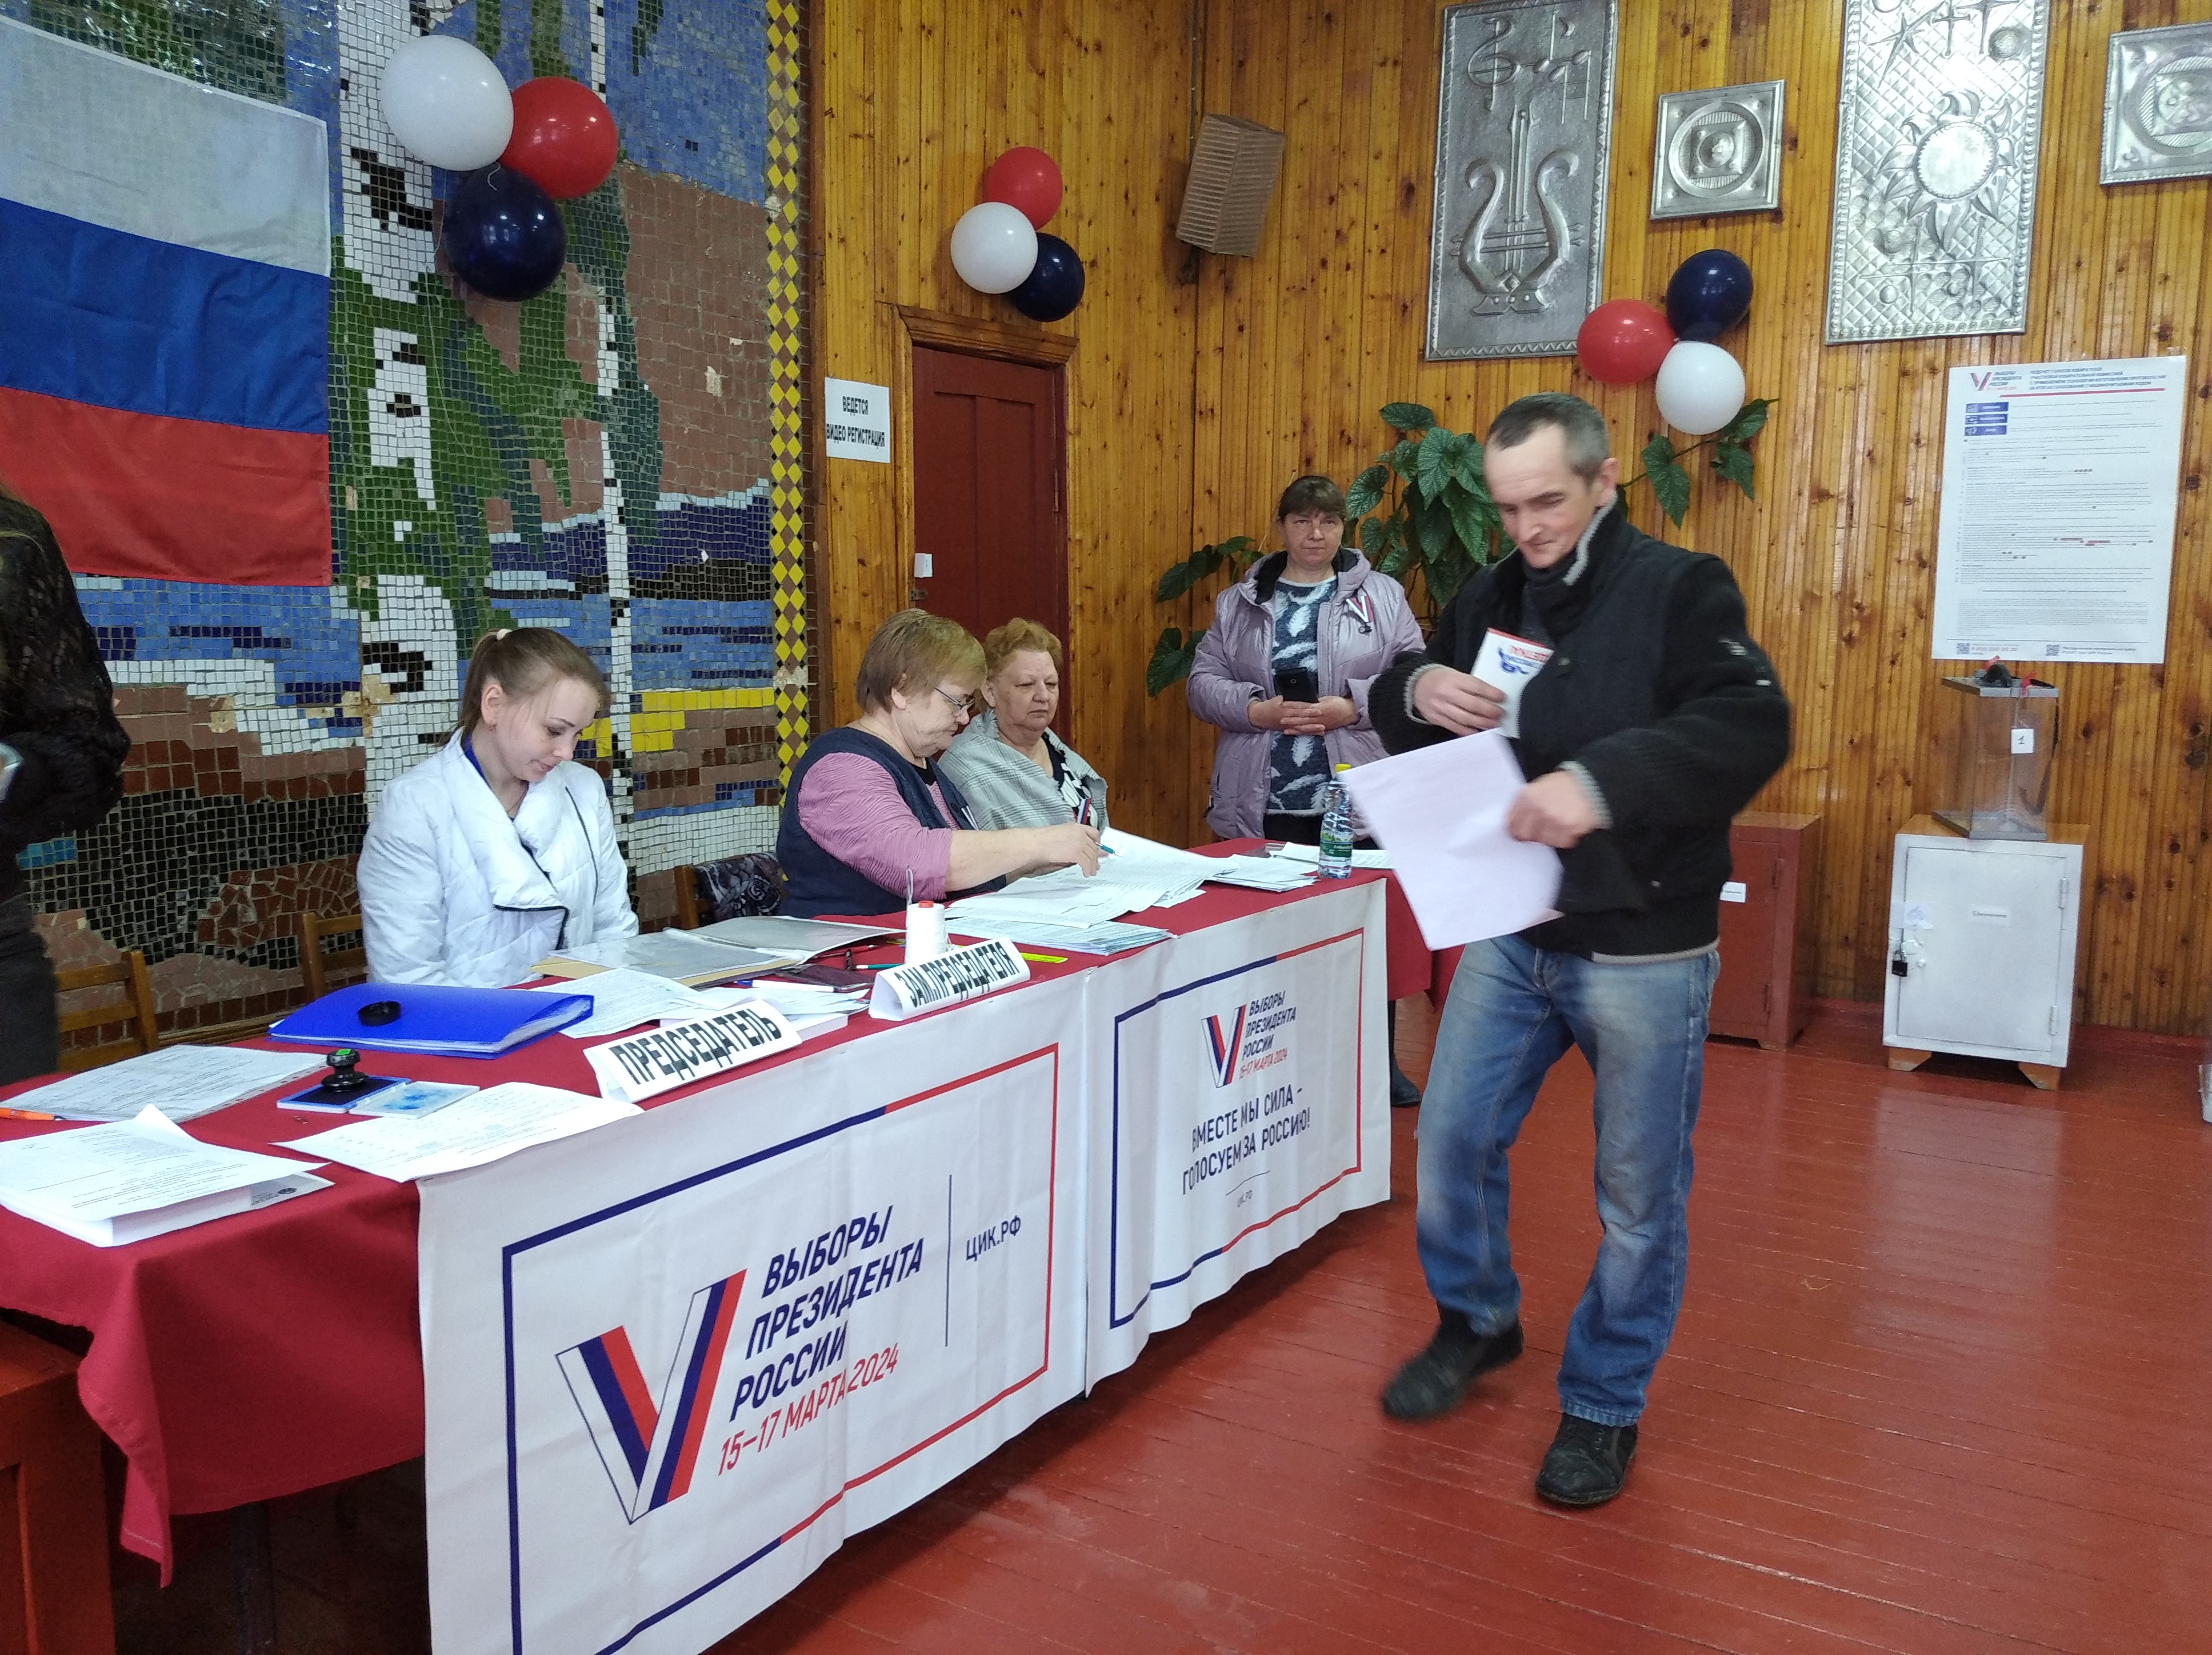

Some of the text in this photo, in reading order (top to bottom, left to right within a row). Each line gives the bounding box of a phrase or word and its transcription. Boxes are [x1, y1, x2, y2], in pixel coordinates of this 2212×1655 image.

[842, 396, 869, 415] ВЕДЕТСЯ
[826, 423, 885, 449] ВИДЕО РЕГИСТРАЦИЯ
[2017, 735, 2025, 745] 1
[1245, 1006, 1297, 1038] ПРЕЗИДЕНТА
[1249, 990, 1286, 1016] ВЫБОРЫ
[608, 1009, 782, 1085] ПРЕДСЕДАТЕЛЬ
[1242, 1033, 1274, 1061] РОССИИ
[1192, 1108, 1238, 1153] ВМЕСТЕ
[1240, 1097, 1260, 1128] МЫ
[1264, 1084, 1294, 1117] СИЛА
[1243, 1132, 1257, 1158] ЗА
[1261, 1107, 1311, 1151] РОССИЮ!
[761, 1204, 894, 1299] ВЫБОРЫ
[966, 1215, 1022, 1262] ЦИК.РФ
[745, 1237, 924, 1360] ПРЕЗИДЕНТА
[729, 1320, 849, 1423] РОССИИ
[781, 1369, 847, 1439] МАРТА
[847, 1342, 899, 1394] 2024
